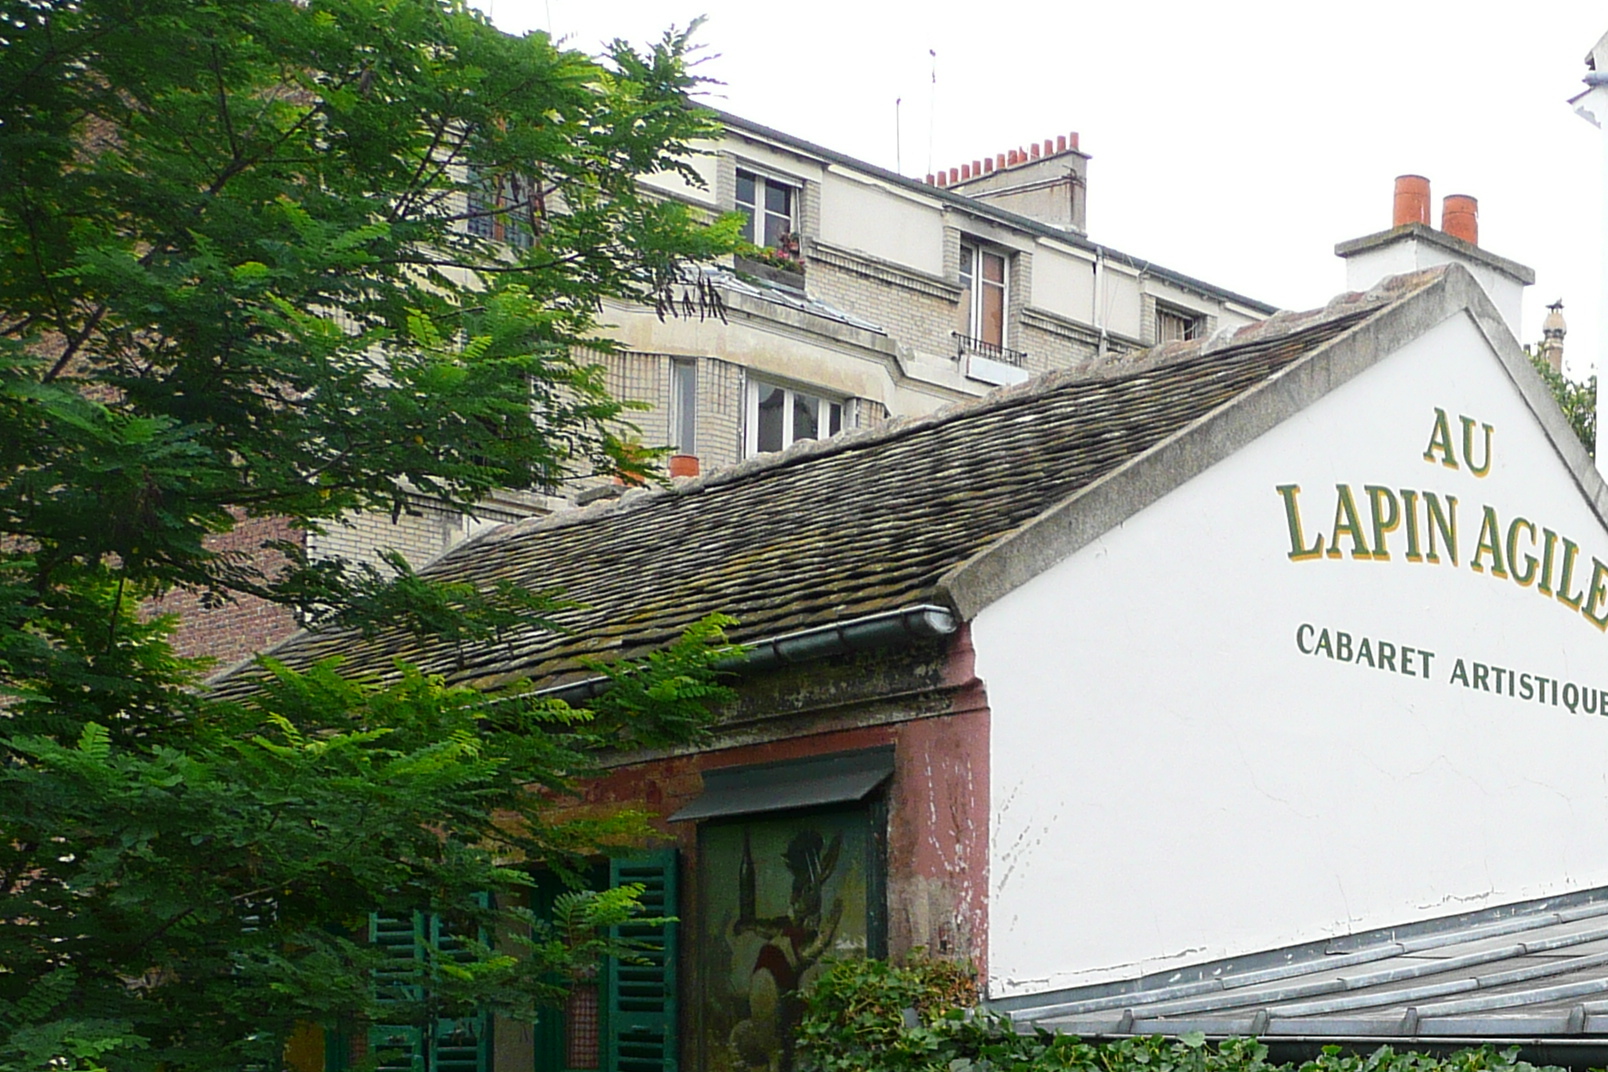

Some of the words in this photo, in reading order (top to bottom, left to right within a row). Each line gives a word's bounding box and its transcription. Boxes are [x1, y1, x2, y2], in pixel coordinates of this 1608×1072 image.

[1423, 407, 1494, 478] AU
[1275, 484, 1459, 567] LAPIN
[1295, 623, 1435, 679] CABARET
